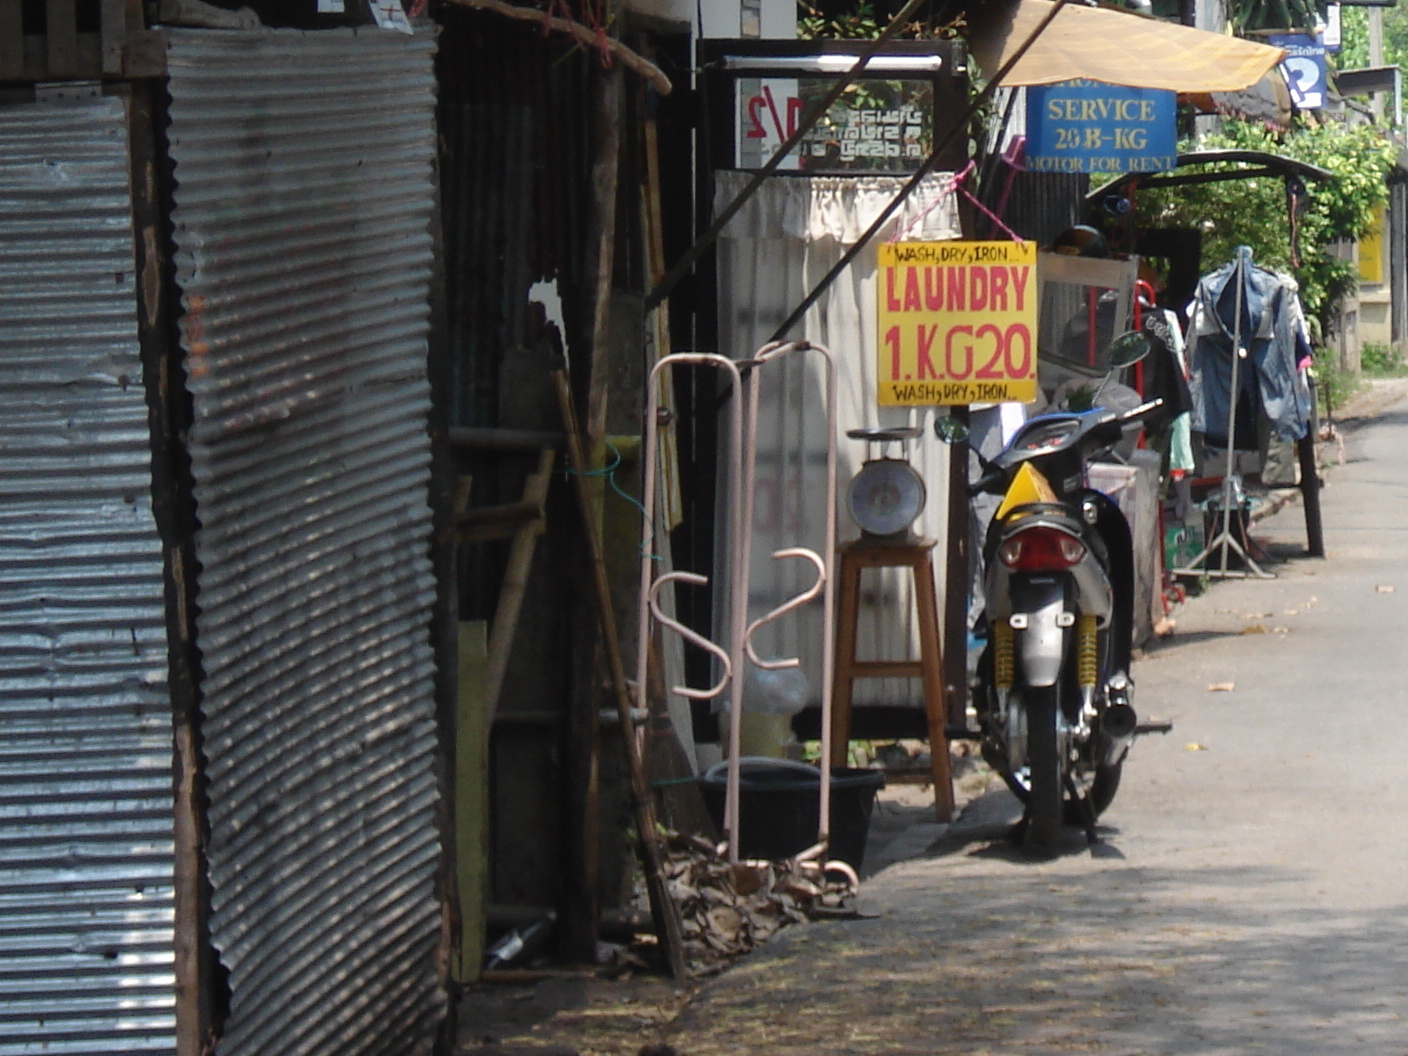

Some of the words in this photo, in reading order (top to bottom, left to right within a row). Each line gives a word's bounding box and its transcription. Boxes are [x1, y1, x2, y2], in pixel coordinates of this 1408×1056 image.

[1048, 98, 1156, 122] SERVICE
[1090, 156, 1121, 171] FOR
[1129, 156, 1173, 172] RENT
[886, 266, 1030, 312] LAUNDRY
